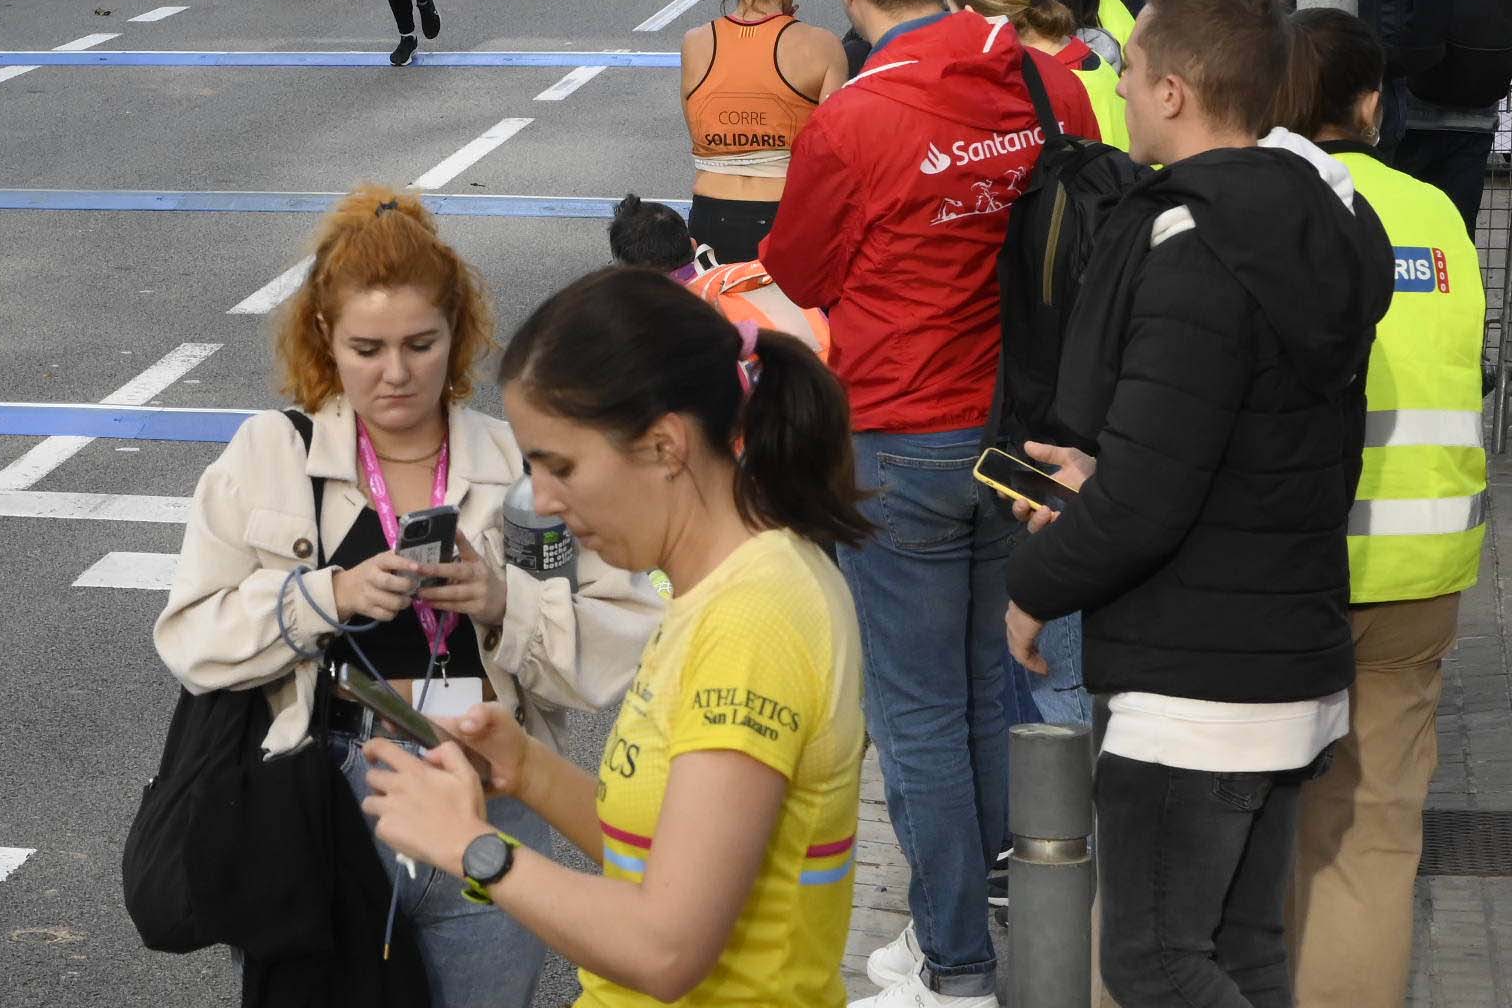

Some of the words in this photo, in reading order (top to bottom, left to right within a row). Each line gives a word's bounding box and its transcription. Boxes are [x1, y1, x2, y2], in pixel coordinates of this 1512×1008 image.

[718, 110, 768, 127] CORRE
[704, 132, 787, 149] SOLIDARIS
[951, 120, 1066, 168] Santanr
[1435, 249, 1447, 292] 2000
[690, 687, 802, 734] ATHLETICS
[702, 710, 727, 728] San
